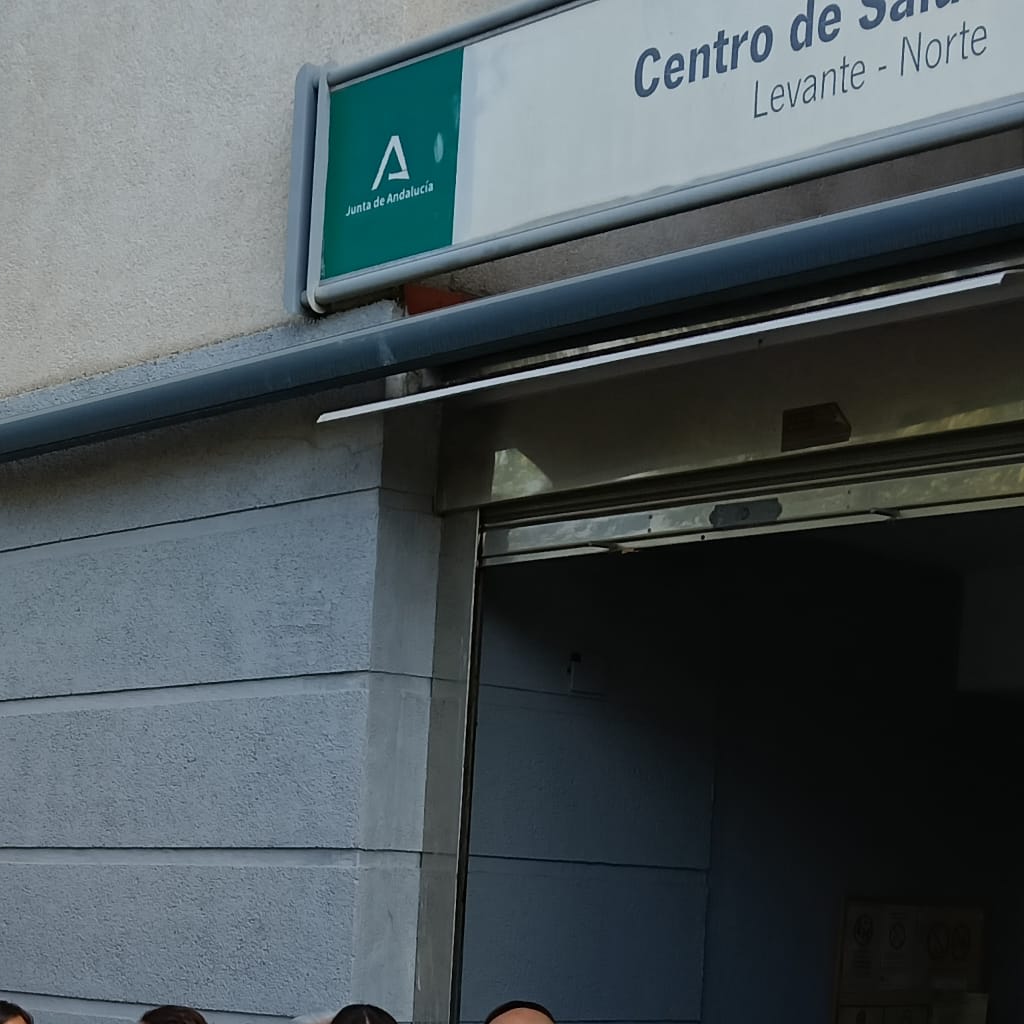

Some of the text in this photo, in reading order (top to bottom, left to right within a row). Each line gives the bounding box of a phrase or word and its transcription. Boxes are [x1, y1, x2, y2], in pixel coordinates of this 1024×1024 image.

[634, 24, 773, 98] Centro
[790, 0, 842, 51] de
[753, 56, 866, 119] Levante
[900, 21, 988, 76] Norte
[346, 180, 434, 217] Junta de Andalucía
